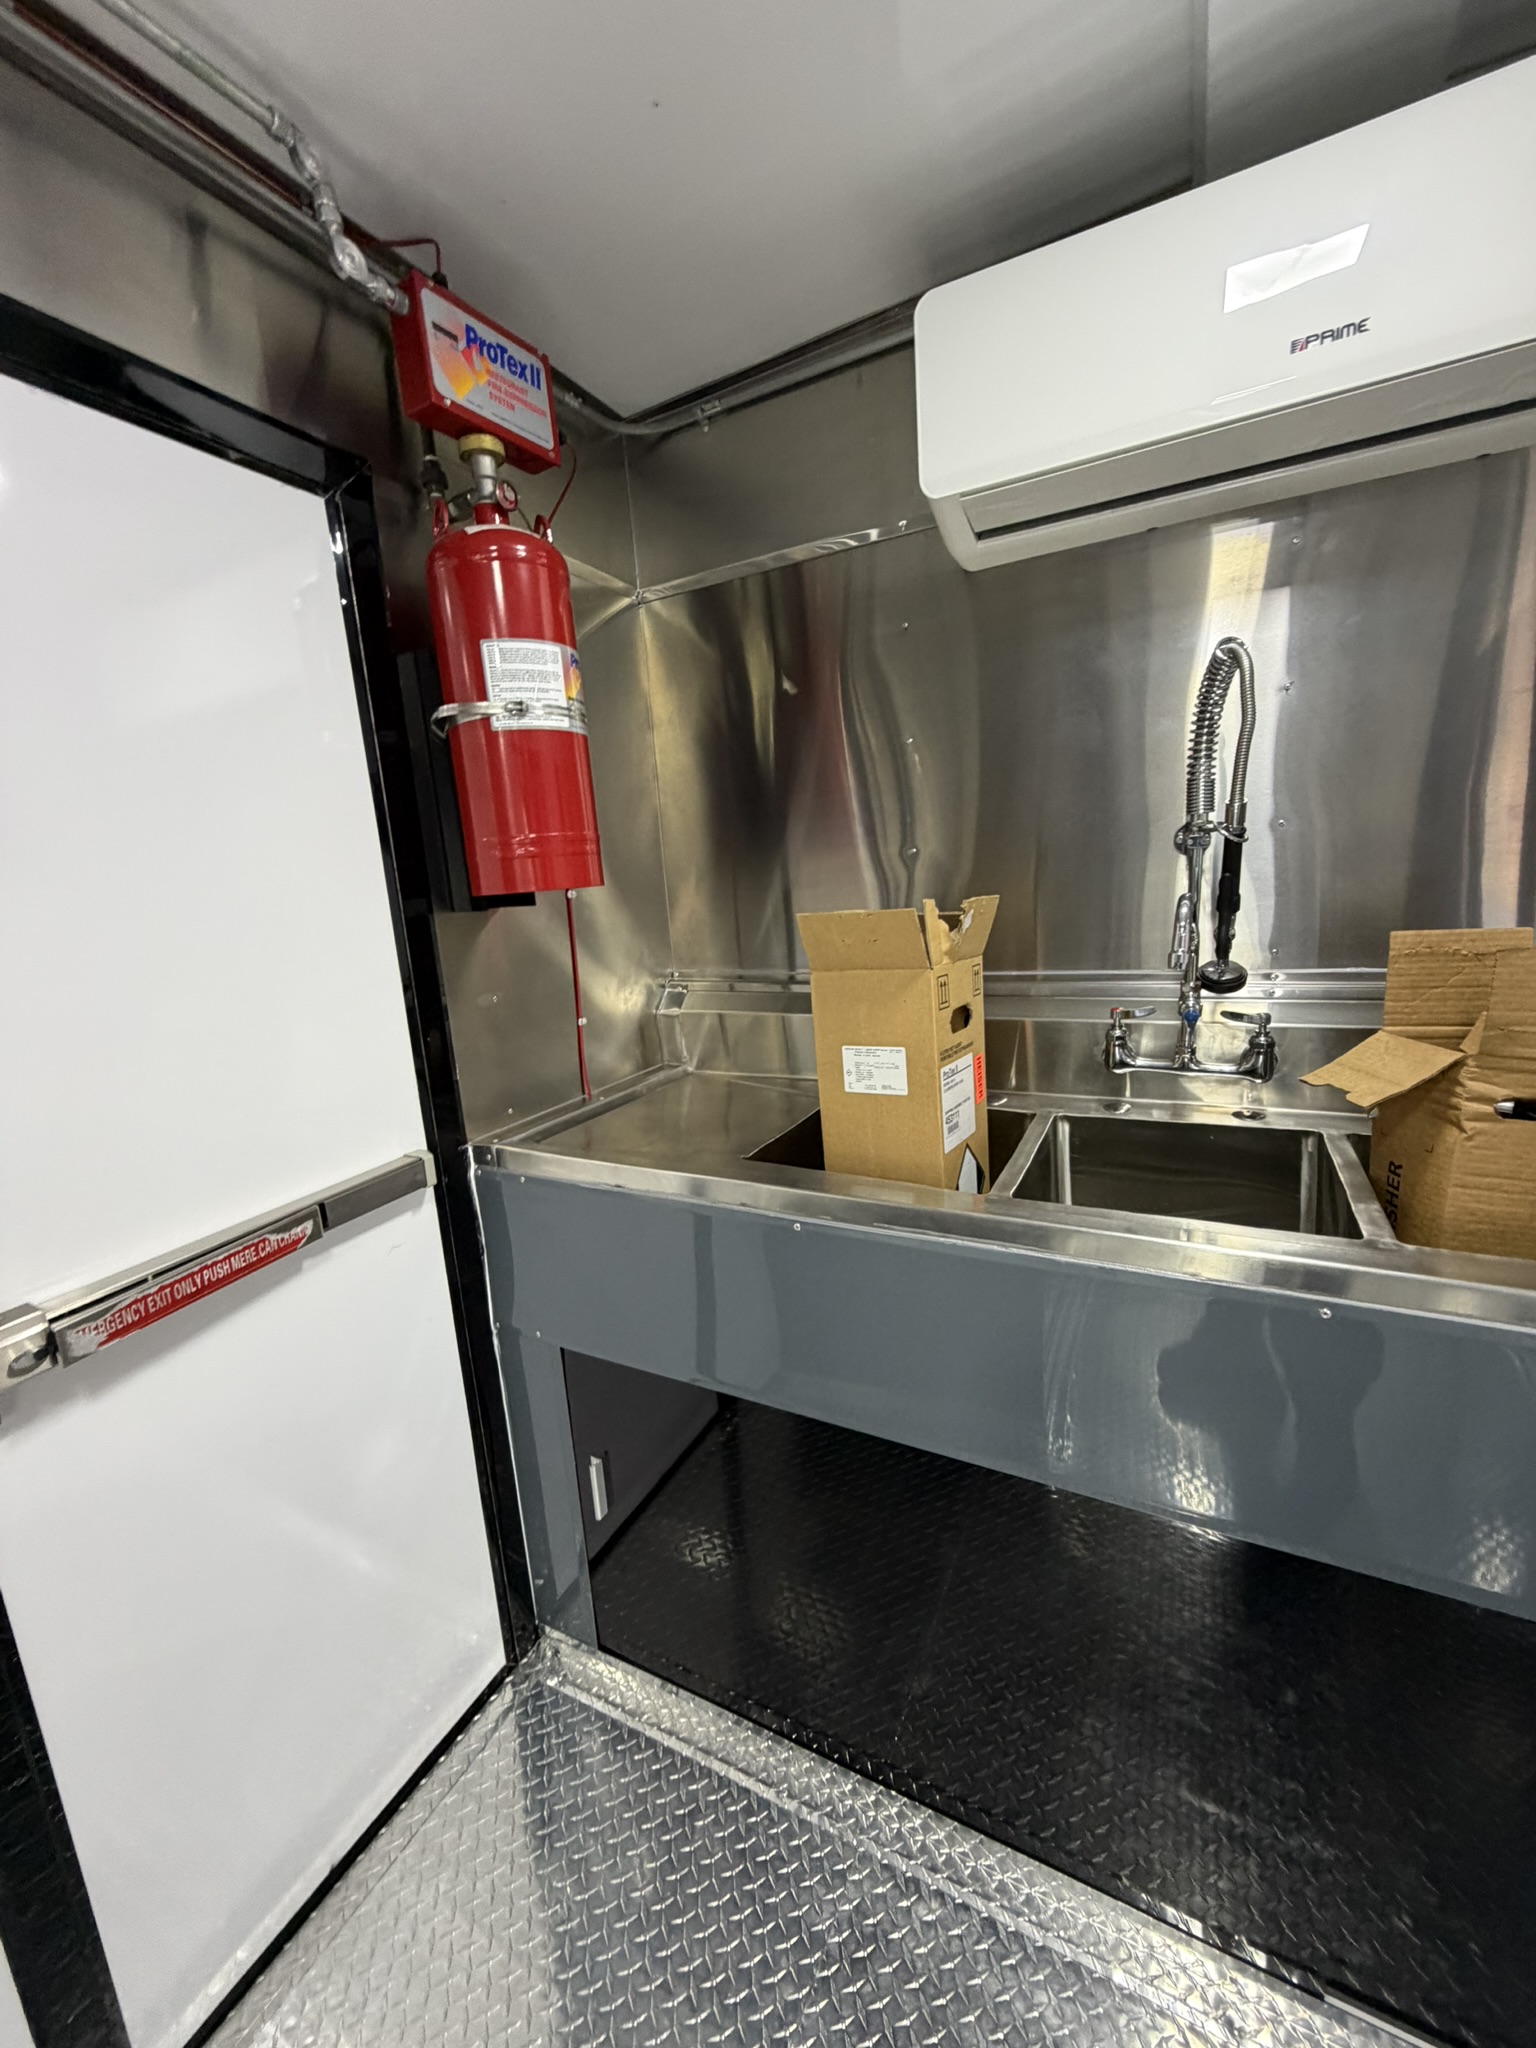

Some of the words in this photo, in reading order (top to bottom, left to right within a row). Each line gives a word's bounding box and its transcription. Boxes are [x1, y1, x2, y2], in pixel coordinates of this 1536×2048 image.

[465, 323, 528, 383] ProTex
[530, 363, 541, 390] II
[1304, 317, 1371, 350] PRIME
[1386, 1161, 1403, 1230] SHER
[147, 1287, 171, 1313] EXIT
[173, 1272, 201, 1300] ONLY
[203, 1258, 231, 1286] PUSH
